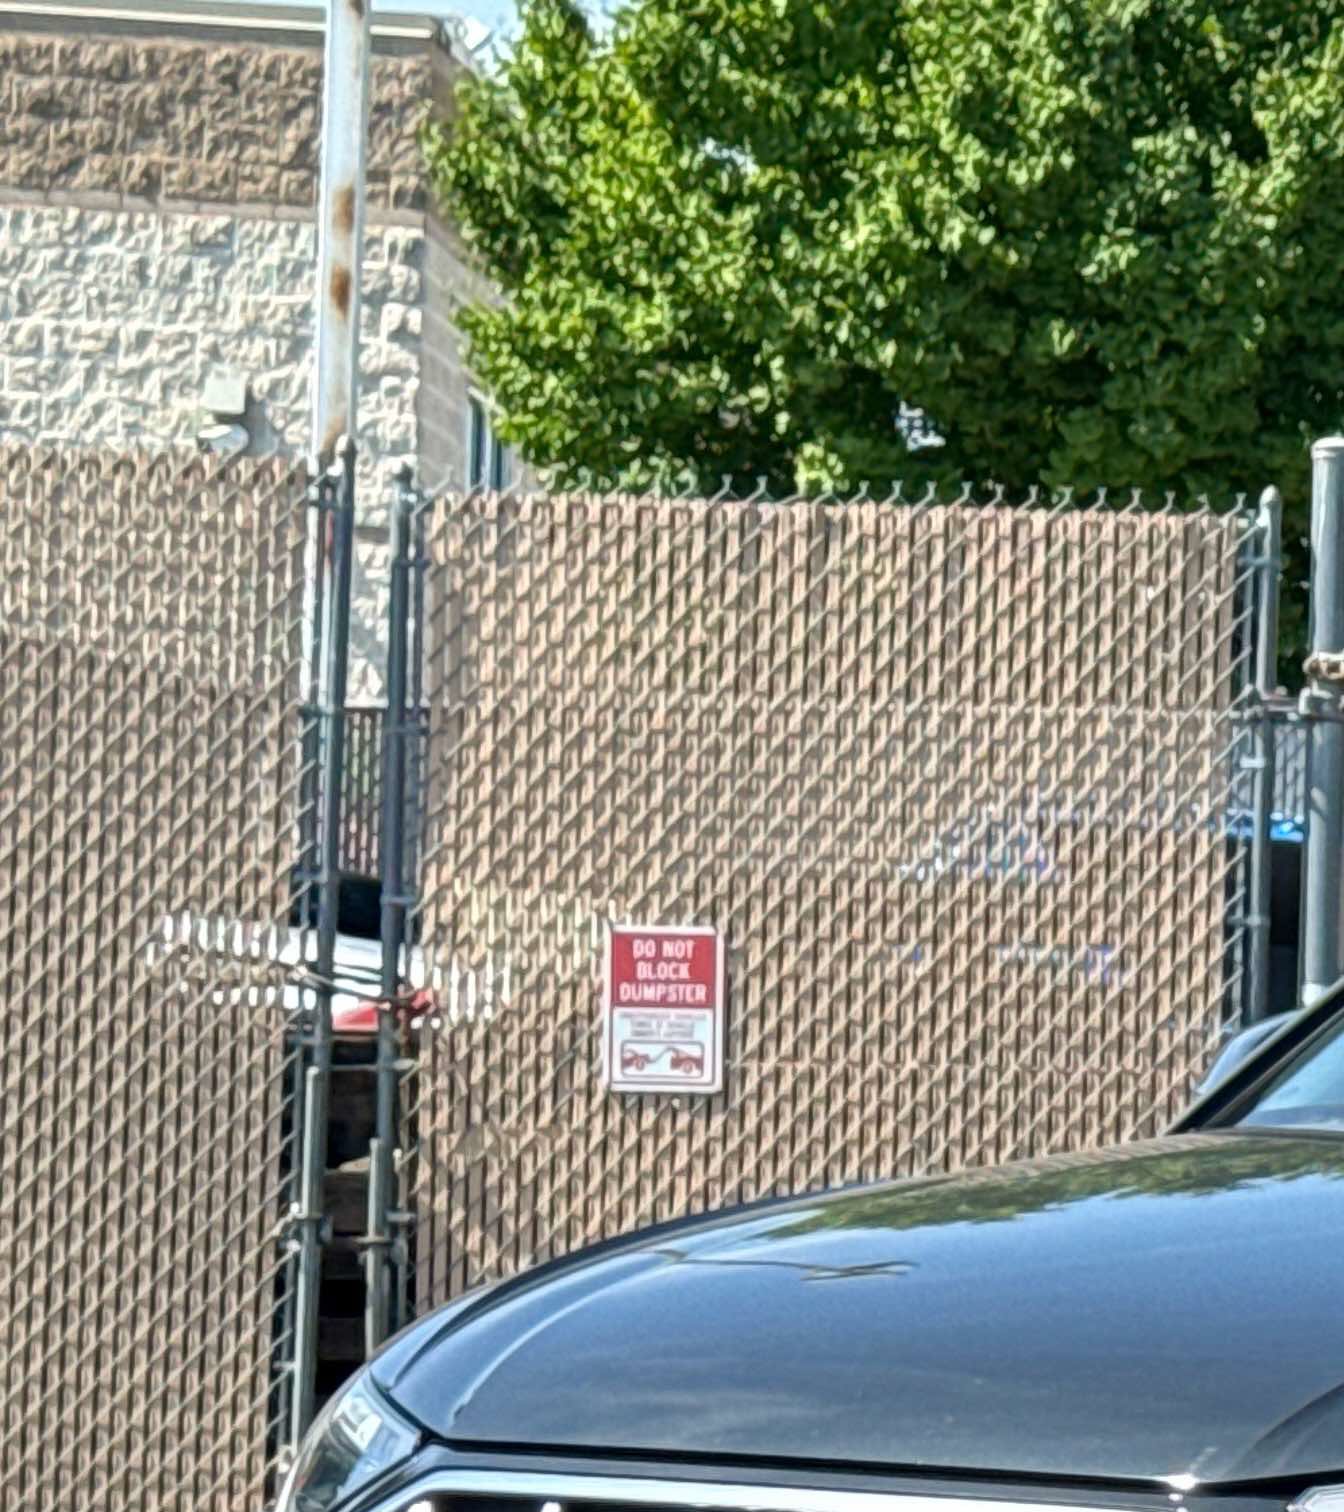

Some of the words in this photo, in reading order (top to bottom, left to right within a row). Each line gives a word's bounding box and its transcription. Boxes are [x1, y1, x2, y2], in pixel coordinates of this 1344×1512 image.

[632, 939, 656, 959] DO
[662, 940, 695, 959] NOT
[636, 961, 690, 980] BLOCK
[619, 982, 707, 1002] DUMPSTER
